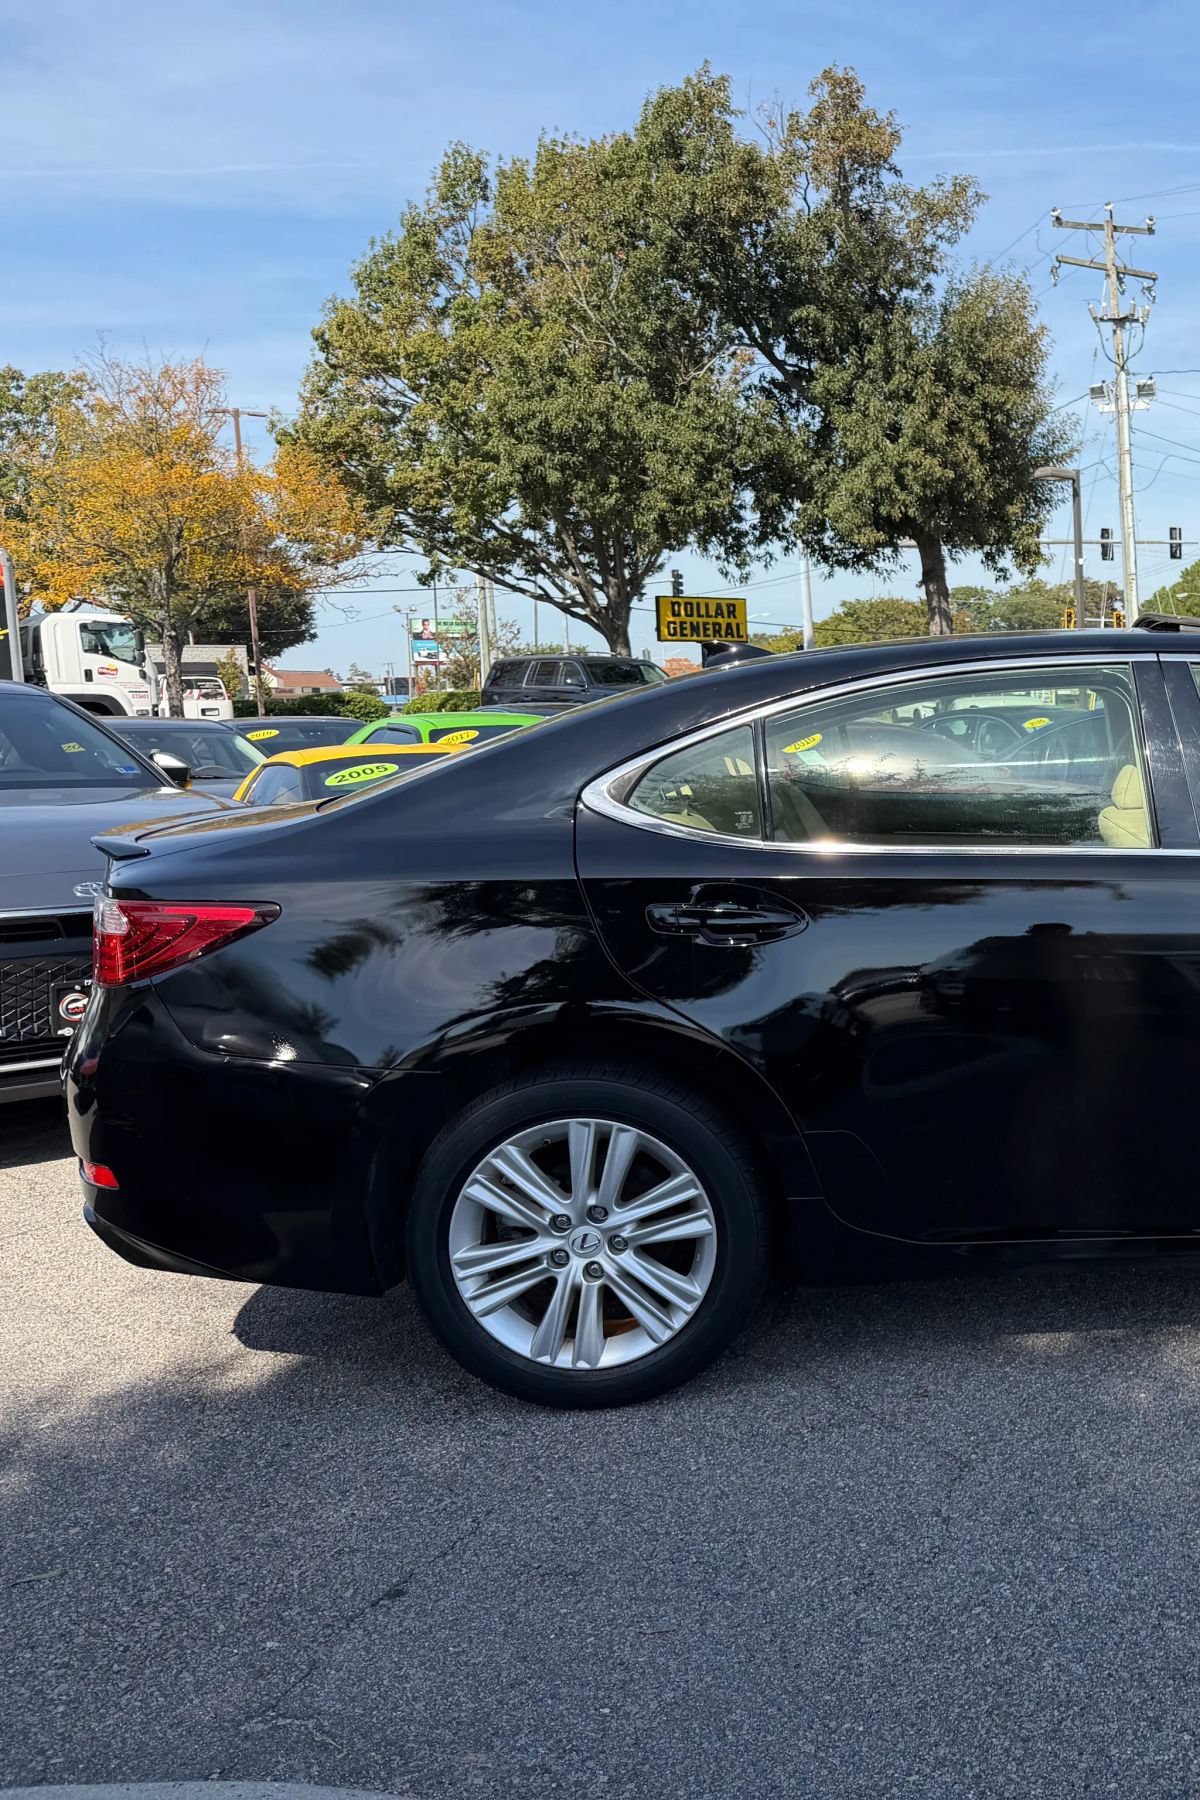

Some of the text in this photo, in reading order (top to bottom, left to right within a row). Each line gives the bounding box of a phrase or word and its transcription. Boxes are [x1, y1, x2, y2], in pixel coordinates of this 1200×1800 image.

[671, 600, 737, 619] DOLLAR
[667, 620, 744, 639] GENERAL
[334, 764, 388, 784] 2005
